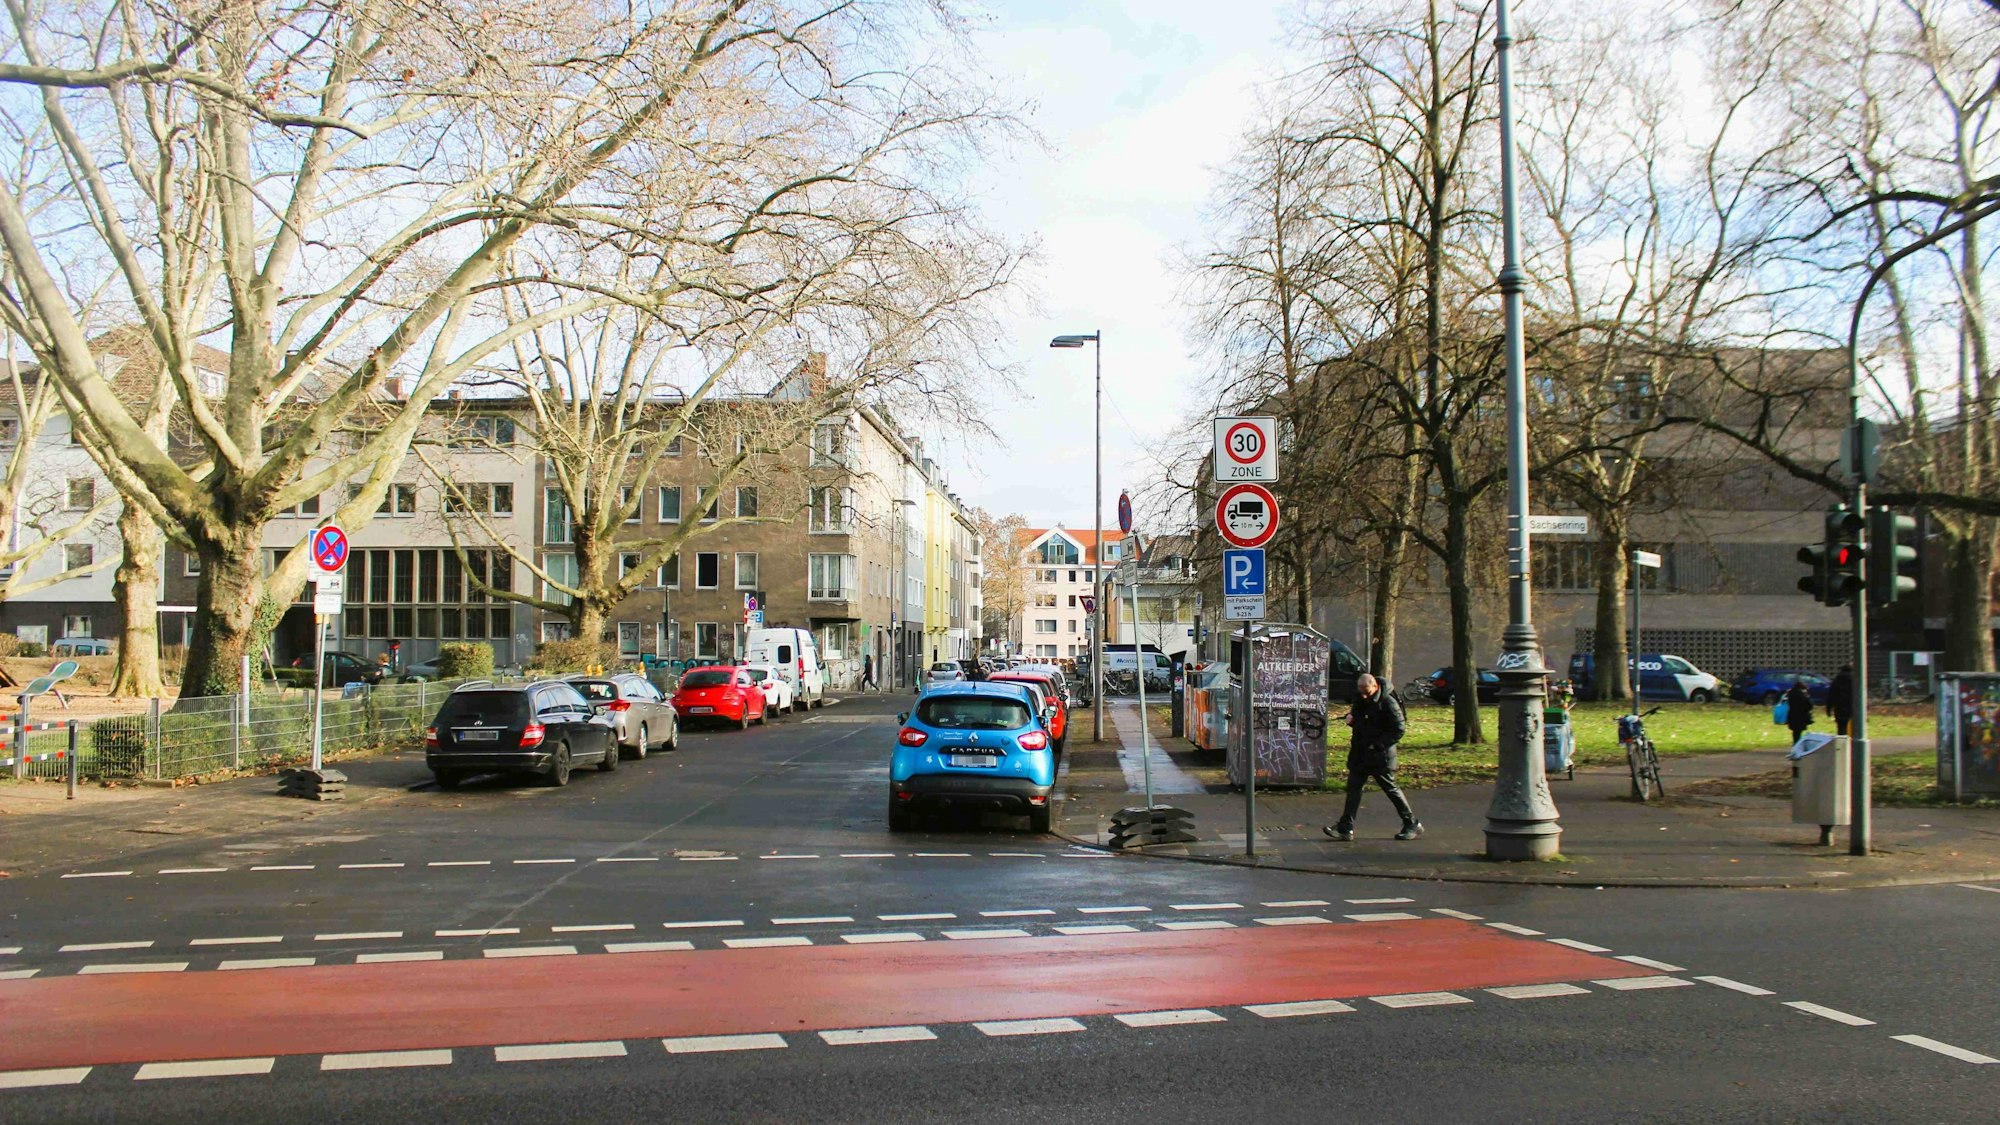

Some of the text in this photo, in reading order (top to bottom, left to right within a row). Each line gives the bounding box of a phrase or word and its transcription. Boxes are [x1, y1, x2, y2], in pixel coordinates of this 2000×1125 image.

[1233, 434, 1257, 453] 30
[1231, 467, 1262, 477] ZONE
[1530, 520, 1586, 532] Sachsenring
[1230, 555, 1252, 590] P
[1271, 701, 1316, 709] Umweltchutz
